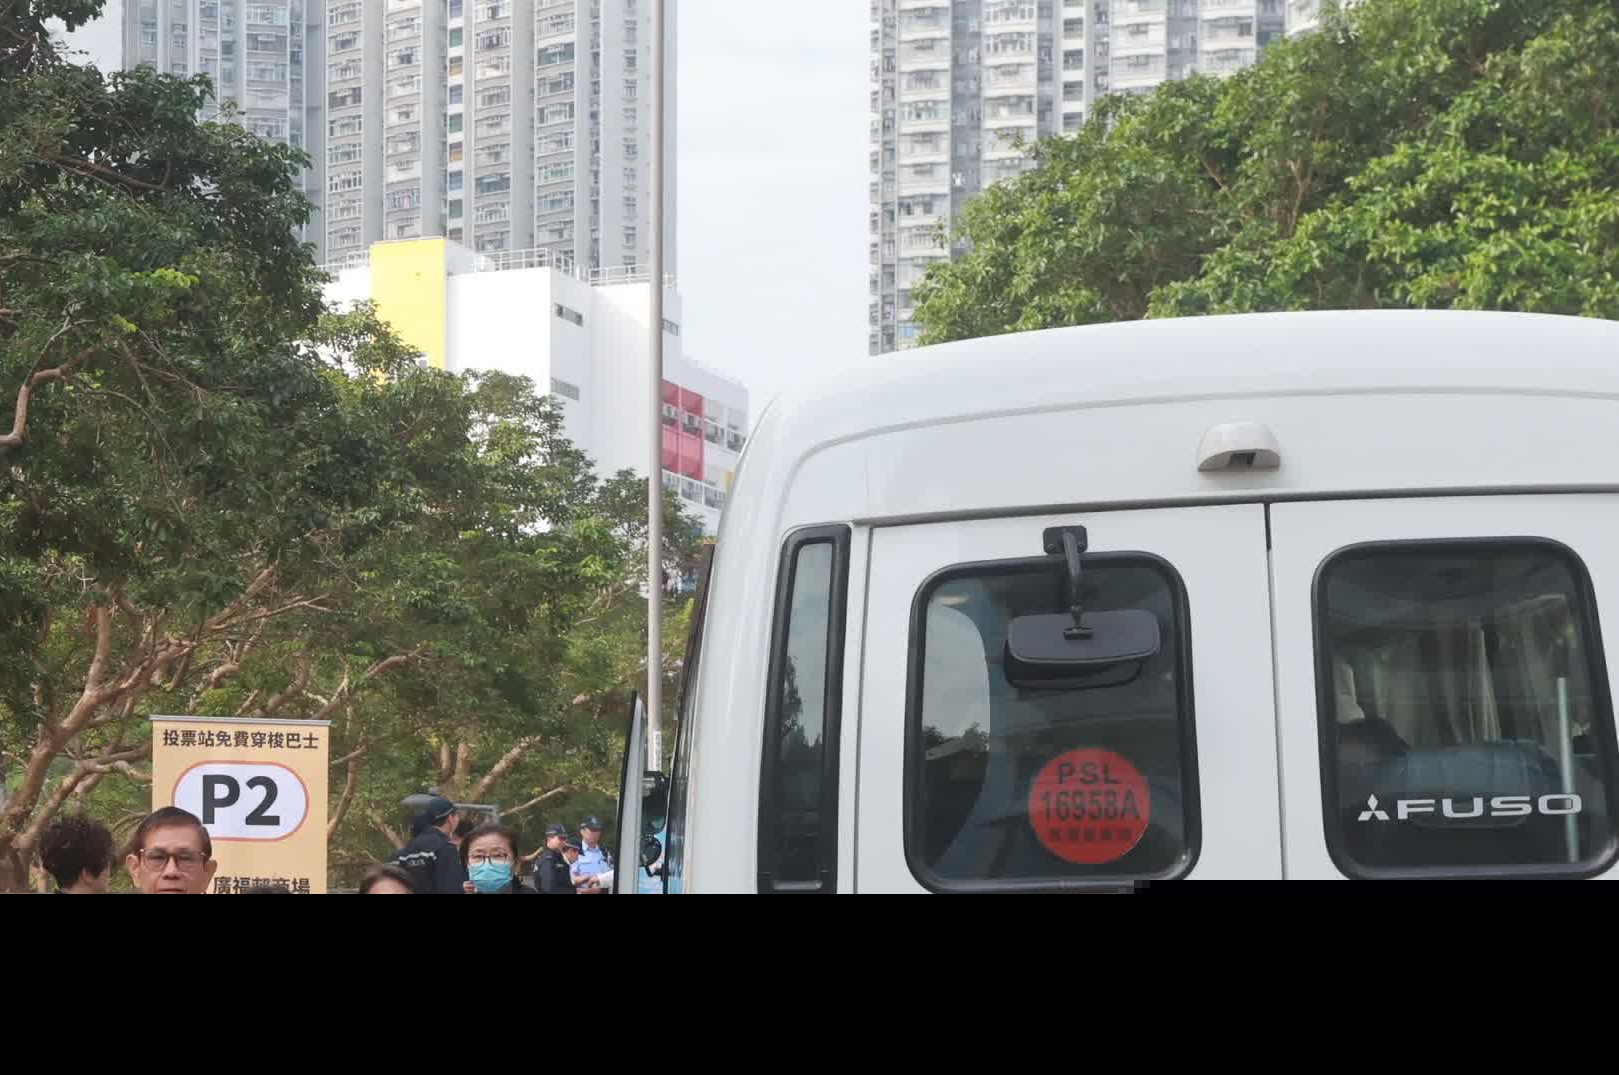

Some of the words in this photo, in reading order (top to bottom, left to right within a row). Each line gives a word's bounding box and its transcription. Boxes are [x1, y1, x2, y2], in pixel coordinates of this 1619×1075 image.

[163, 729, 318, 749] 投票站免費穿梭巴士
[1059, 762, 1120, 784] PSL
[202, 774, 280, 826] P2
[1397, 794, 1582, 820] FUSO
